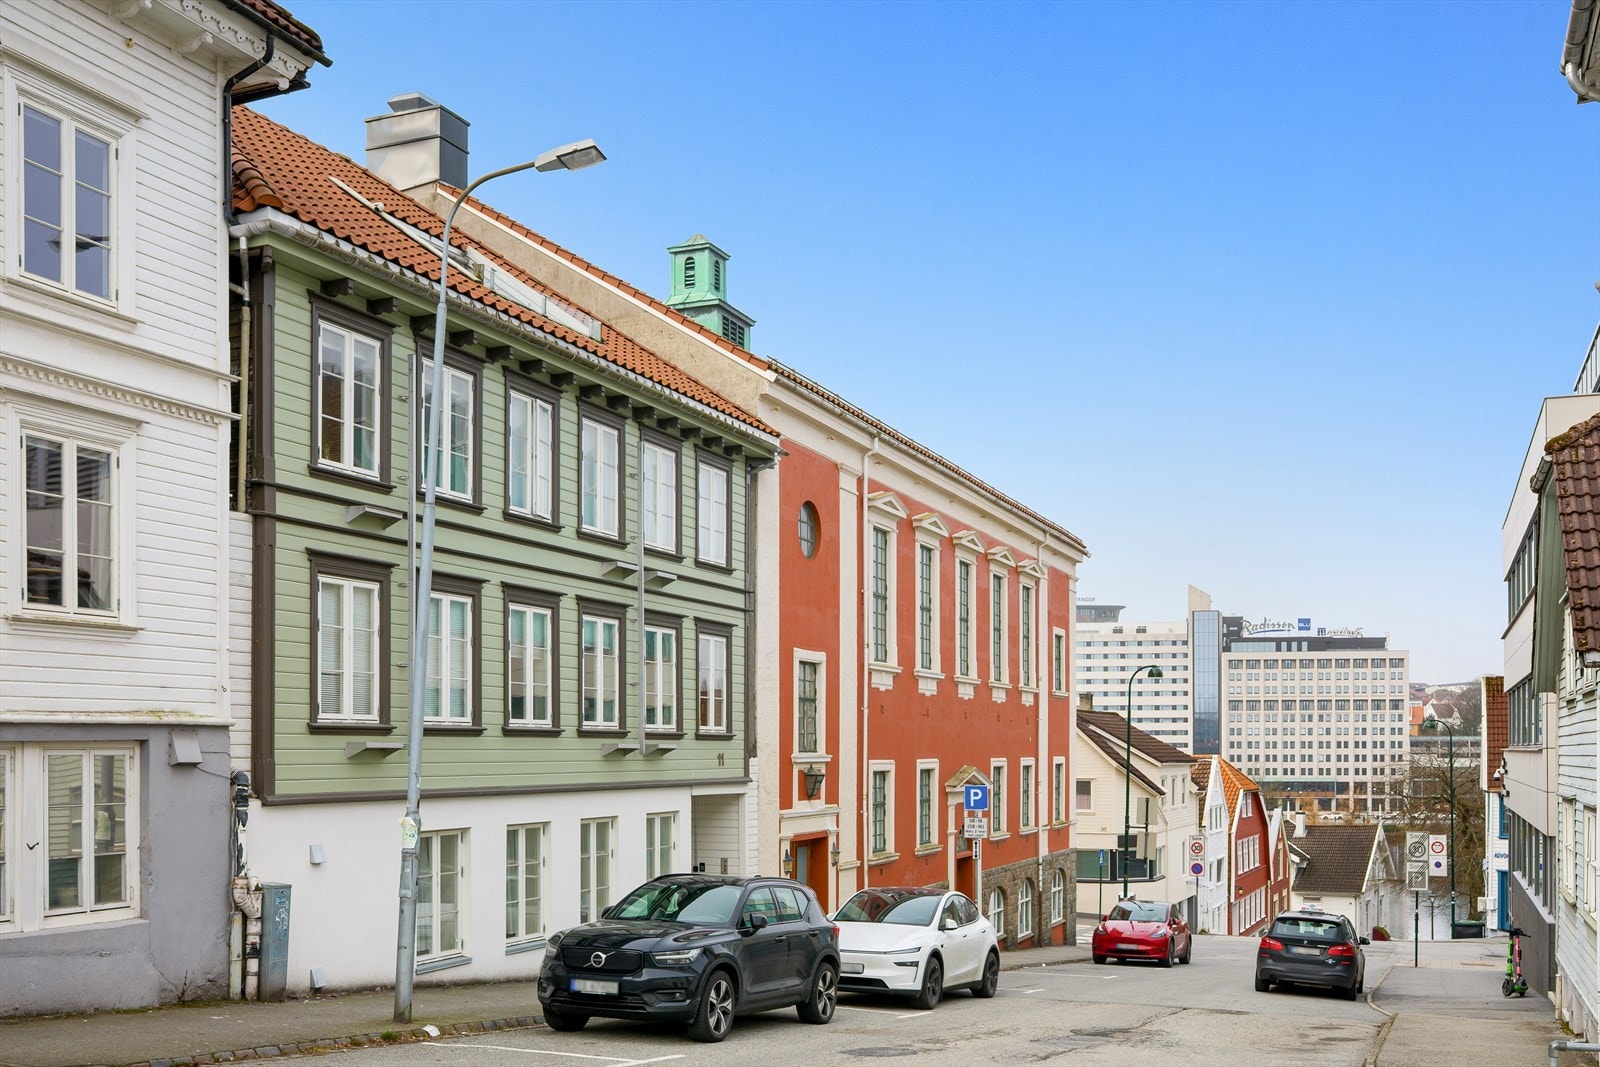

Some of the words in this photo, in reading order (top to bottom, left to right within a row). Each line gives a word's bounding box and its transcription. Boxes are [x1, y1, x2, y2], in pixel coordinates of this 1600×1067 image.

[1240, 617, 1295, 636] Radisson
[717, 752, 725, 767] 11
[970, 788, 983, 807] P
